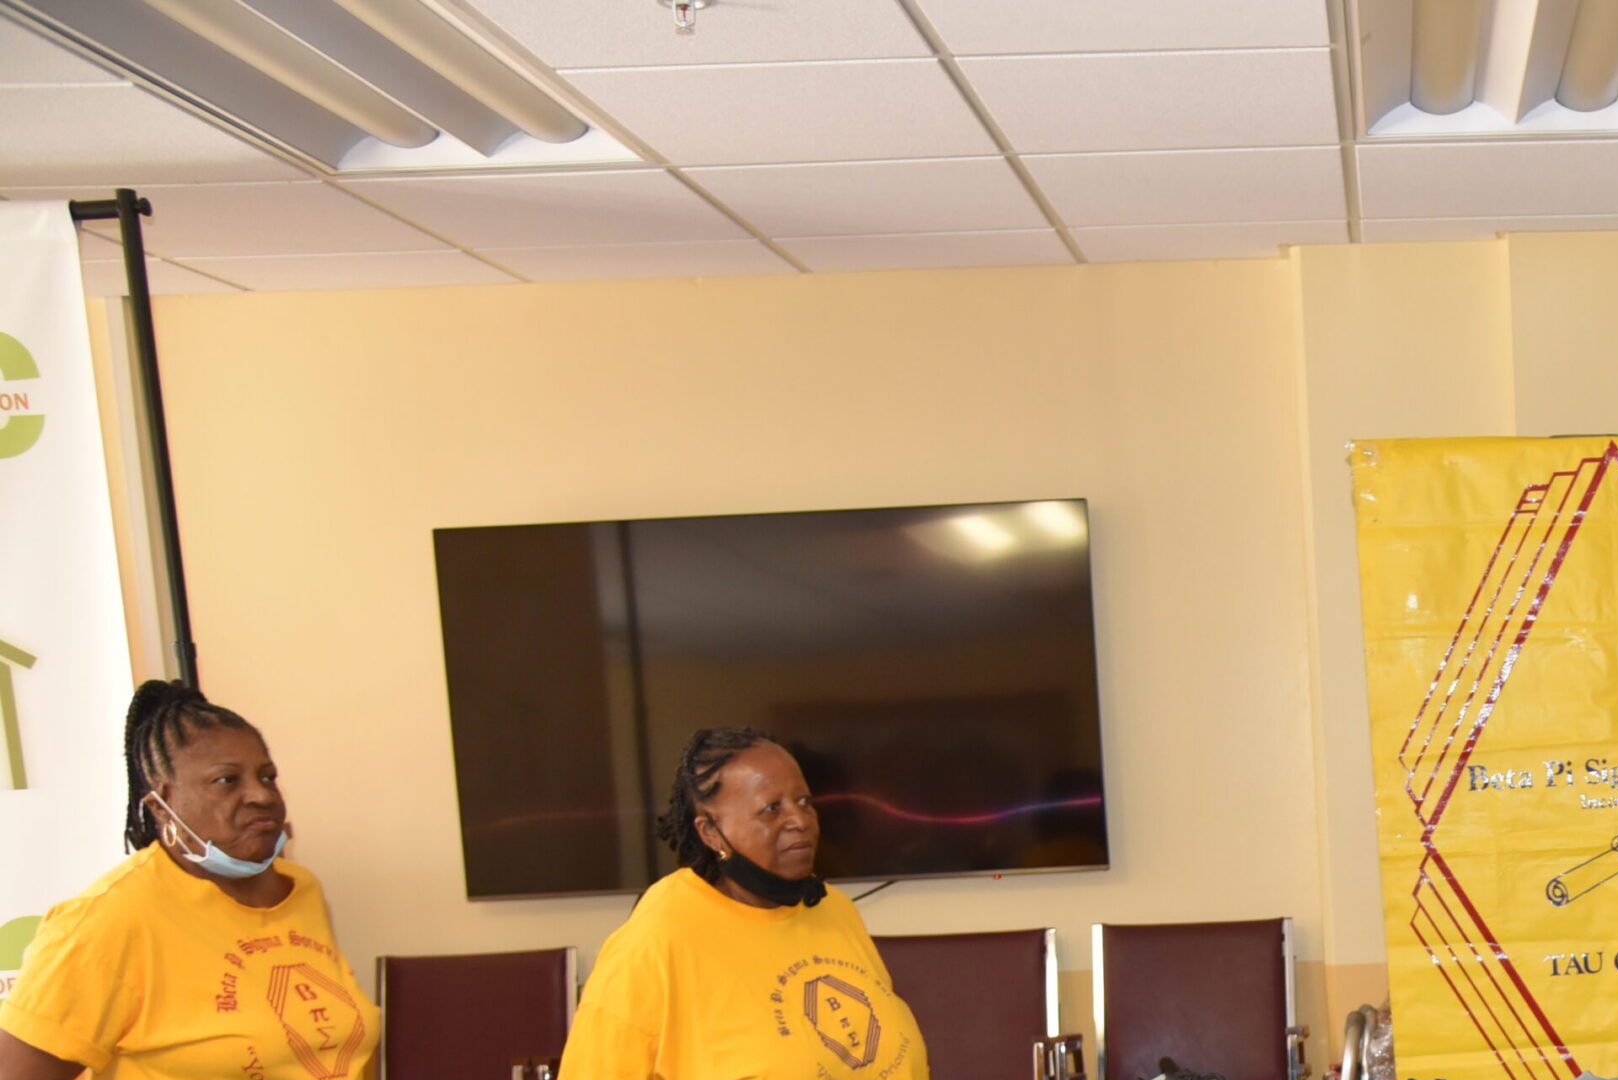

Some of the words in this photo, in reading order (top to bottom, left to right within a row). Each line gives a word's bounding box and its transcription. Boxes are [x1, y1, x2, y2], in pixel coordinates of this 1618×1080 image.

[1467, 764, 1533, 791] Beta
[1546, 759, 1574, 787] Pi
[1544, 951, 1603, 977] TAU
